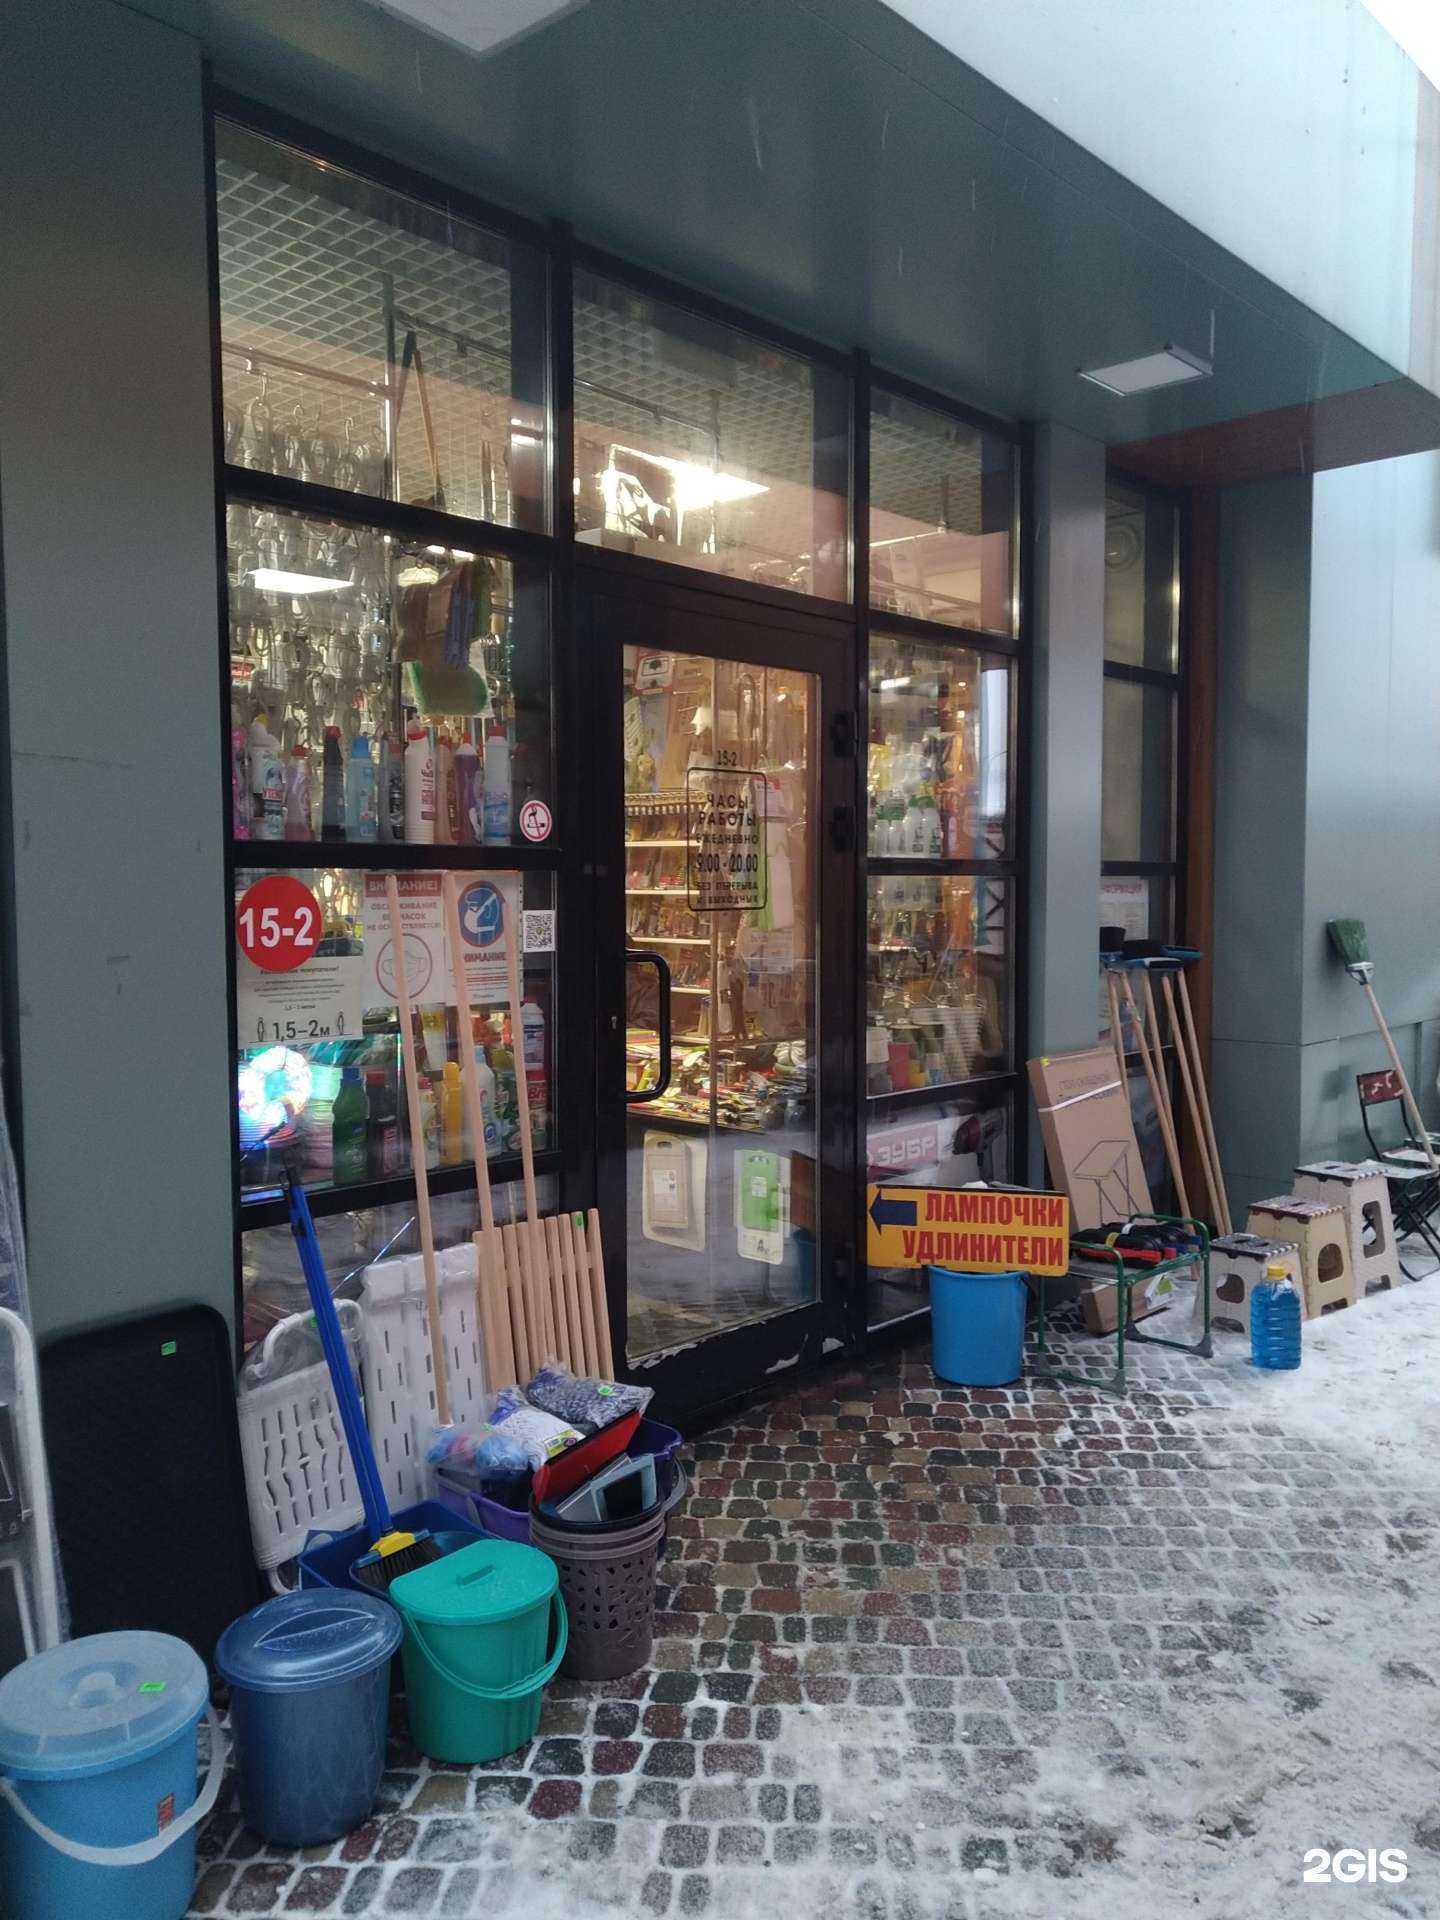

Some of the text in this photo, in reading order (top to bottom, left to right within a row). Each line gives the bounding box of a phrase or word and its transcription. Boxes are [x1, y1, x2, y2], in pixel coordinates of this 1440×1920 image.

[707, 794, 749, 809] ЧАСЫ
[699, 811, 757, 827] РАБОТЫ
[696, 833, 759, 845] ЕЖЕДНЕВНО
[730, 853, 759, 873] 20.00
[239, 906, 314, 949] 15-2
[876, 1135, 937, 1168] ЗУБР
[925, 1193, 1064, 1227] ЛАМПОЧКИ
[902, 1230, 1064, 1267] УДЛИНИТЕЛИ
